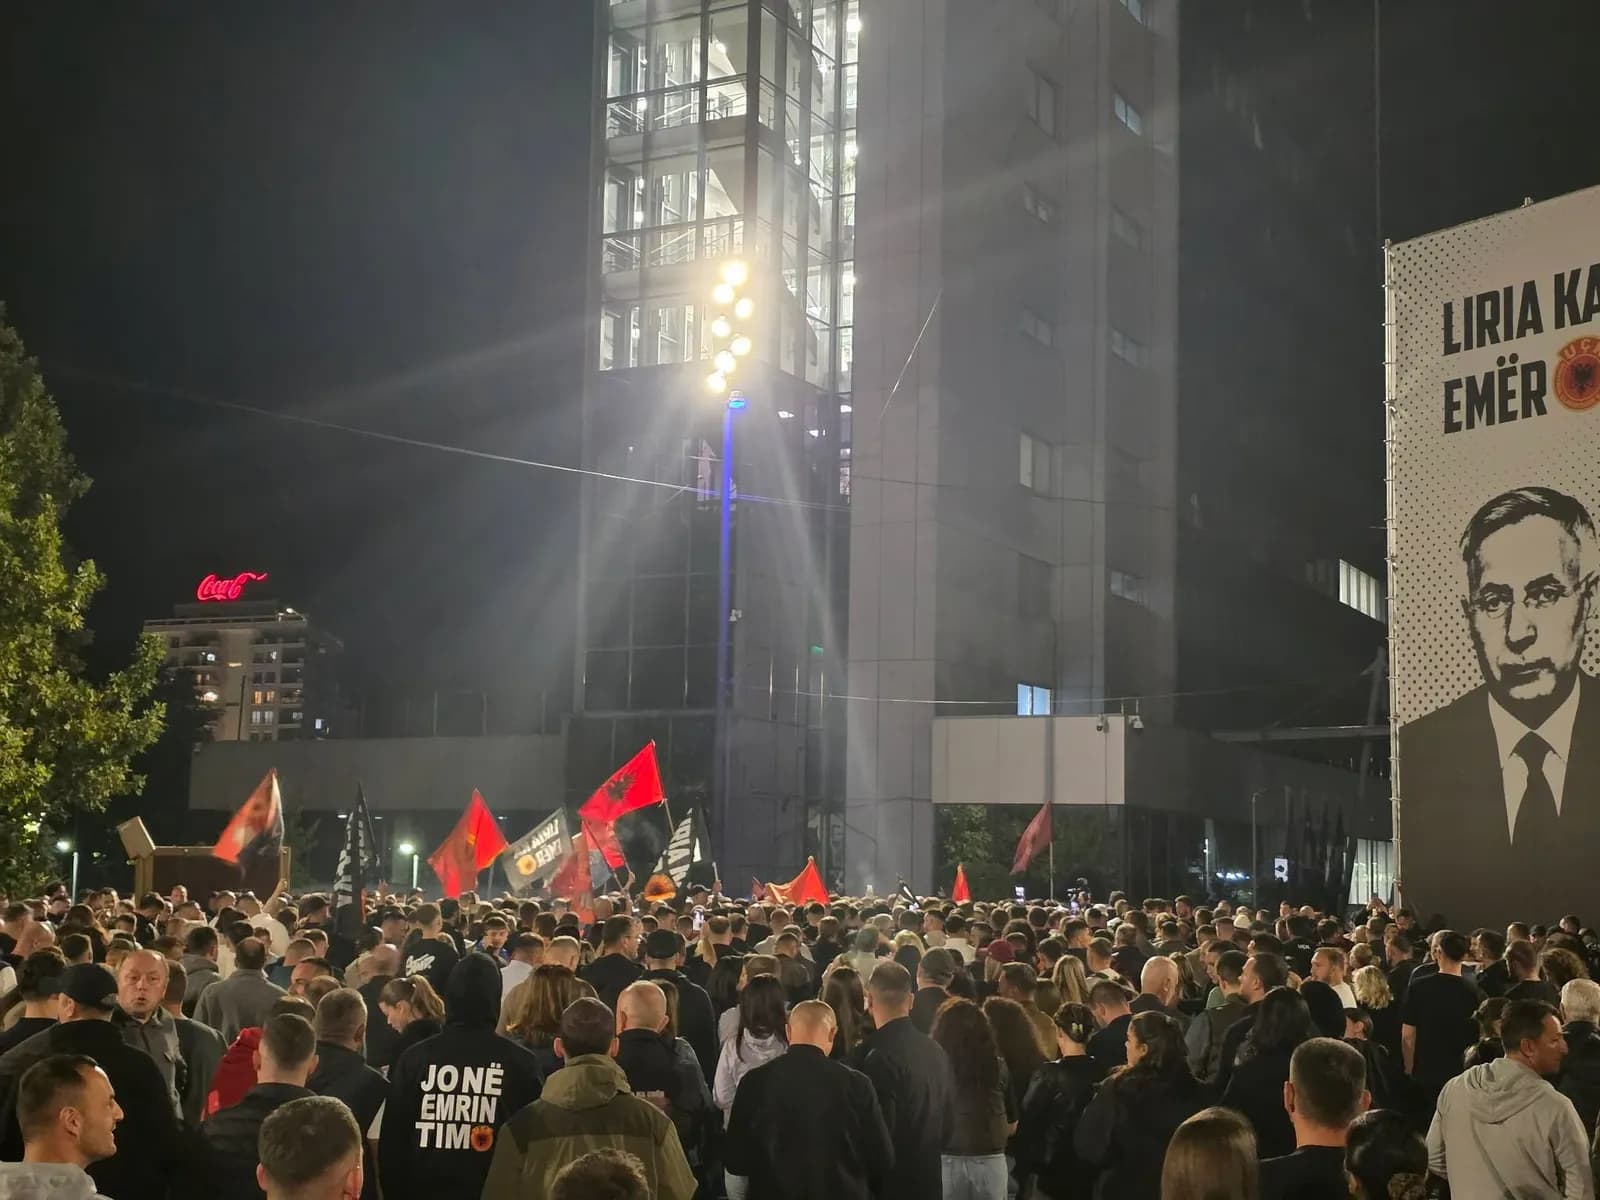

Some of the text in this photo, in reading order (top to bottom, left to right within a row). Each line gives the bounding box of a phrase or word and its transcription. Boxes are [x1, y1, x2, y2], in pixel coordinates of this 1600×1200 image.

[1442, 279, 1544, 356] LIRIA
[1443, 352, 1548, 434] EMËR
[415, 1121, 472, 1150] TIM
[420, 1093, 498, 1124] EMRIN
